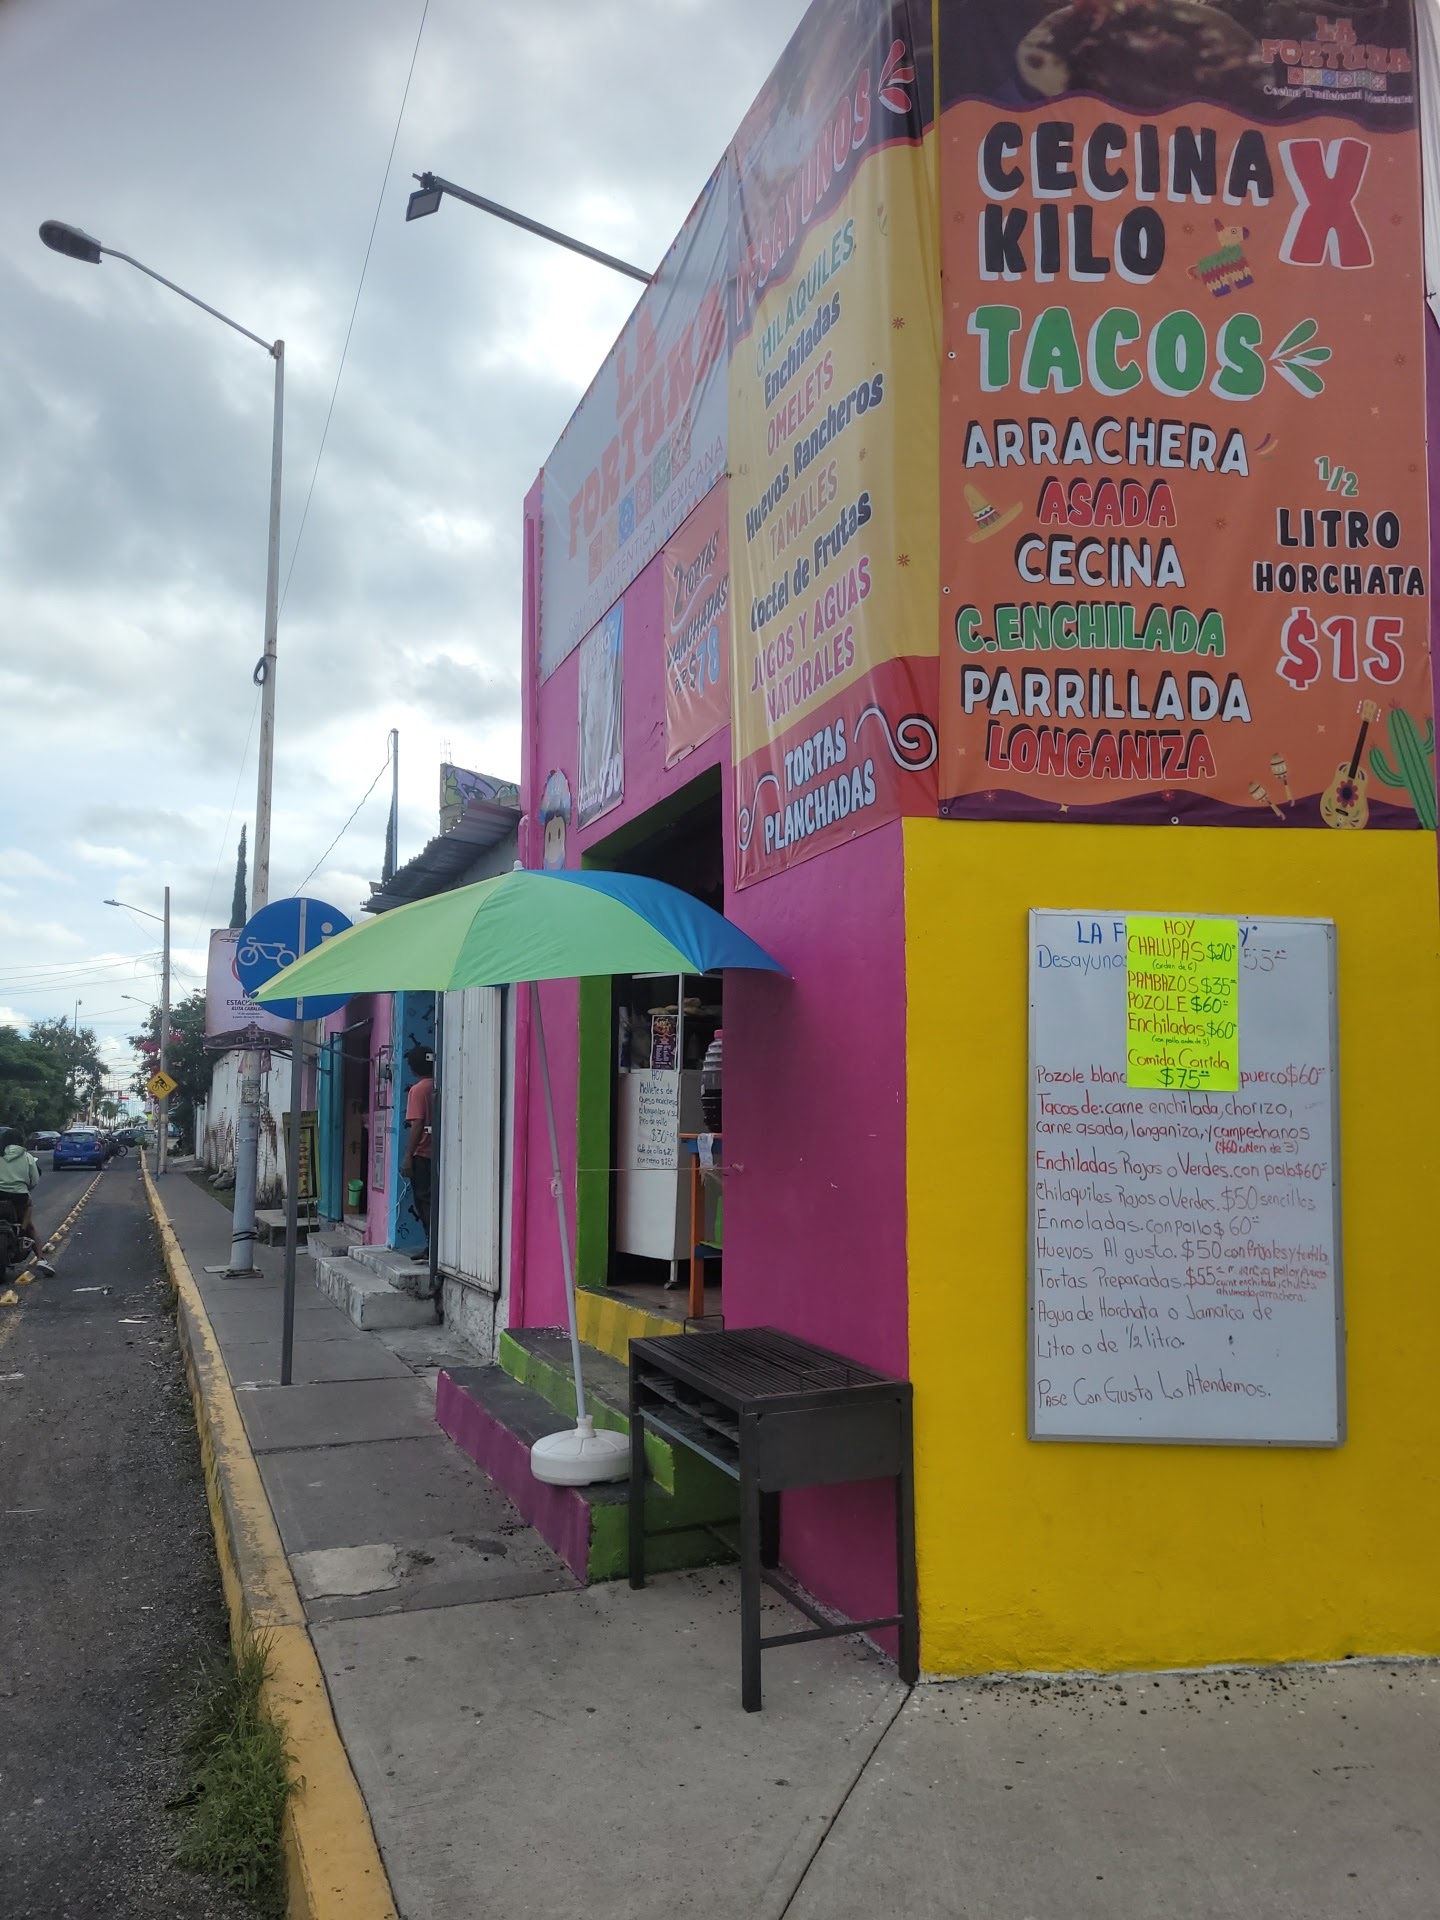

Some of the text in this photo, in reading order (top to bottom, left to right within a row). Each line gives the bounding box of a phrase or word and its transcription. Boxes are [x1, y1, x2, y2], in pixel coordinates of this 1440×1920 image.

[1316, 16, 1357, 44] LA
[1261, 39, 1411, 73] FORTUNA
[736, 68, 871, 326] DESAYUNOS
[977, 121, 1376, 270] CECINA X
[978, 204, 1166, 284] KILO
[756, 218, 854, 378] CHILAQUILES
[616, 305, 657, 421] LA
[764, 291, 841, 410] Enchiladas
[967, 304, 1266, 402] TACOS
[767, 350, 834, 457] OMELETS
[745, 372, 884, 544] Huevos Rancheros
[962, 416, 1250, 477] ARRACHERA
[661, 435, 724, 522] MEXICANA
[1315, 456, 1359, 497] 1/2
[769, 460, 838, 561] TAMALES
[1038, 476, 1178, 527] ASADA
[1276, 507, 1401, 550] LITRO
[673, 528, 719, 618] 2 TORTAS
[750, 491, 872, 632] Coctel de Frutas
[1015, 533, 1186, 589] CECINA
[1252, 562, 1425, 597] HORCHATA
[751, 624, 795, 692] JUGOS
[798, 611, 807, 650] Y
[813, 556, 872, 640] AGUAS
[955, 602, 1226, 657] C.ENCHILADA
[689, 624, 720, 698] $78
[1275, 607, 1404, 690] $15
[766, 625, 855, 727] NATURALES
[961, 665, 1252, 723] PARRILLADA
[784, 717, 847, 792] TORTAS
[986, 720, 1217, 781] LONGANIZA
[764, 758, 876, 855] PLANCHADAS
[1077, 921, 1102, 944] LA
[1127, 935, 1205, 962] CHALUPAS
[1164, 920, 1195, 938] HOY
[1127, 970, 1199, 994] PAMBAZOS
[1152, 958, 1175, 970] (orden
[1178, 961, 1186, 970] de
[1127, 991, 1189, 1013] POZOLE
[1128, 1012, 1206, 1037] Enchiladas
[1165, 1036, 1180, 1046] pollo
[652, 1070, 664, 1081] HOY
[1035, 1064, 1085, 1084] Pozole
[1091, 1063, 1128, 1083] blanc
[1240, 1070, 1287, 1089] puerco
[1128, 1047, 1229, 1071] Comida Corrida
[666, 1082, 673, 1094] de
[1037, 1092, 1079, 1115] Tacos
[1105, 1101, 1144, 1115] carne
[1149, 1091, 1223, 1120] enchilada,
[1225, 1095, 1293, 1118] chorizo,
[1036, 1120, 1073, 1135] carne
[1076, 1116, 1128, 1140] asada,
[1213, 1121, 1310, 1143] campechanos
[1270, 1143, 1282, 1154] de
[1036, 1146, 1118, 1175] Enchiladas
[1118, 1150, 1163, 1181] Rojas
[1167, 1166, 1178, 1178] o
[1233, 1165, 1260, 1178] con
[1036, 1178, 1113, 1207] Chilaquiles
[1115, 1185, 1156, 1209] Rojos
[1158, 1195, 1170, 1207] o
[1221, 1185, 1258, 1213] $50
[1037, 1208, 1144, 1233] Enmoladas.
[1146, 1219, 1173, 1234] con
[1175, 1219, 1212, 1237] pollo
[1036, 1236, 1094, 1260] Huevos
[1103, 1236, 1118, 1258] Al
[1124, 1234, 1177, 1265] gusto.
[1181, 1238, 1222, 1261] $50
[1224, 1246, 1246, 1258] con
[1288, 1247, 1297, 1264] y
[1036, 1266, 1088, 1289] Tortas
[1092, 1265, 1186, 1291] Preparadas.
[1038, 1294, 1273, 1328] Agua de Horchata o Jamaica de
[1037, 1334, 1075, 1359] Litro
[1082, 1343, 1092, 1355] o
[1097, 1328, 1119, 1353] de
[1144, 1325, 1185, 1349] litro.
[1073, 1377, 1102, 1406] Con
[1103, 1374, 1153, 1404] Gusto
[1157, 1370, 1184, 1400] Lo
[1186, 1363, 1271, 1398] Atendemos.
